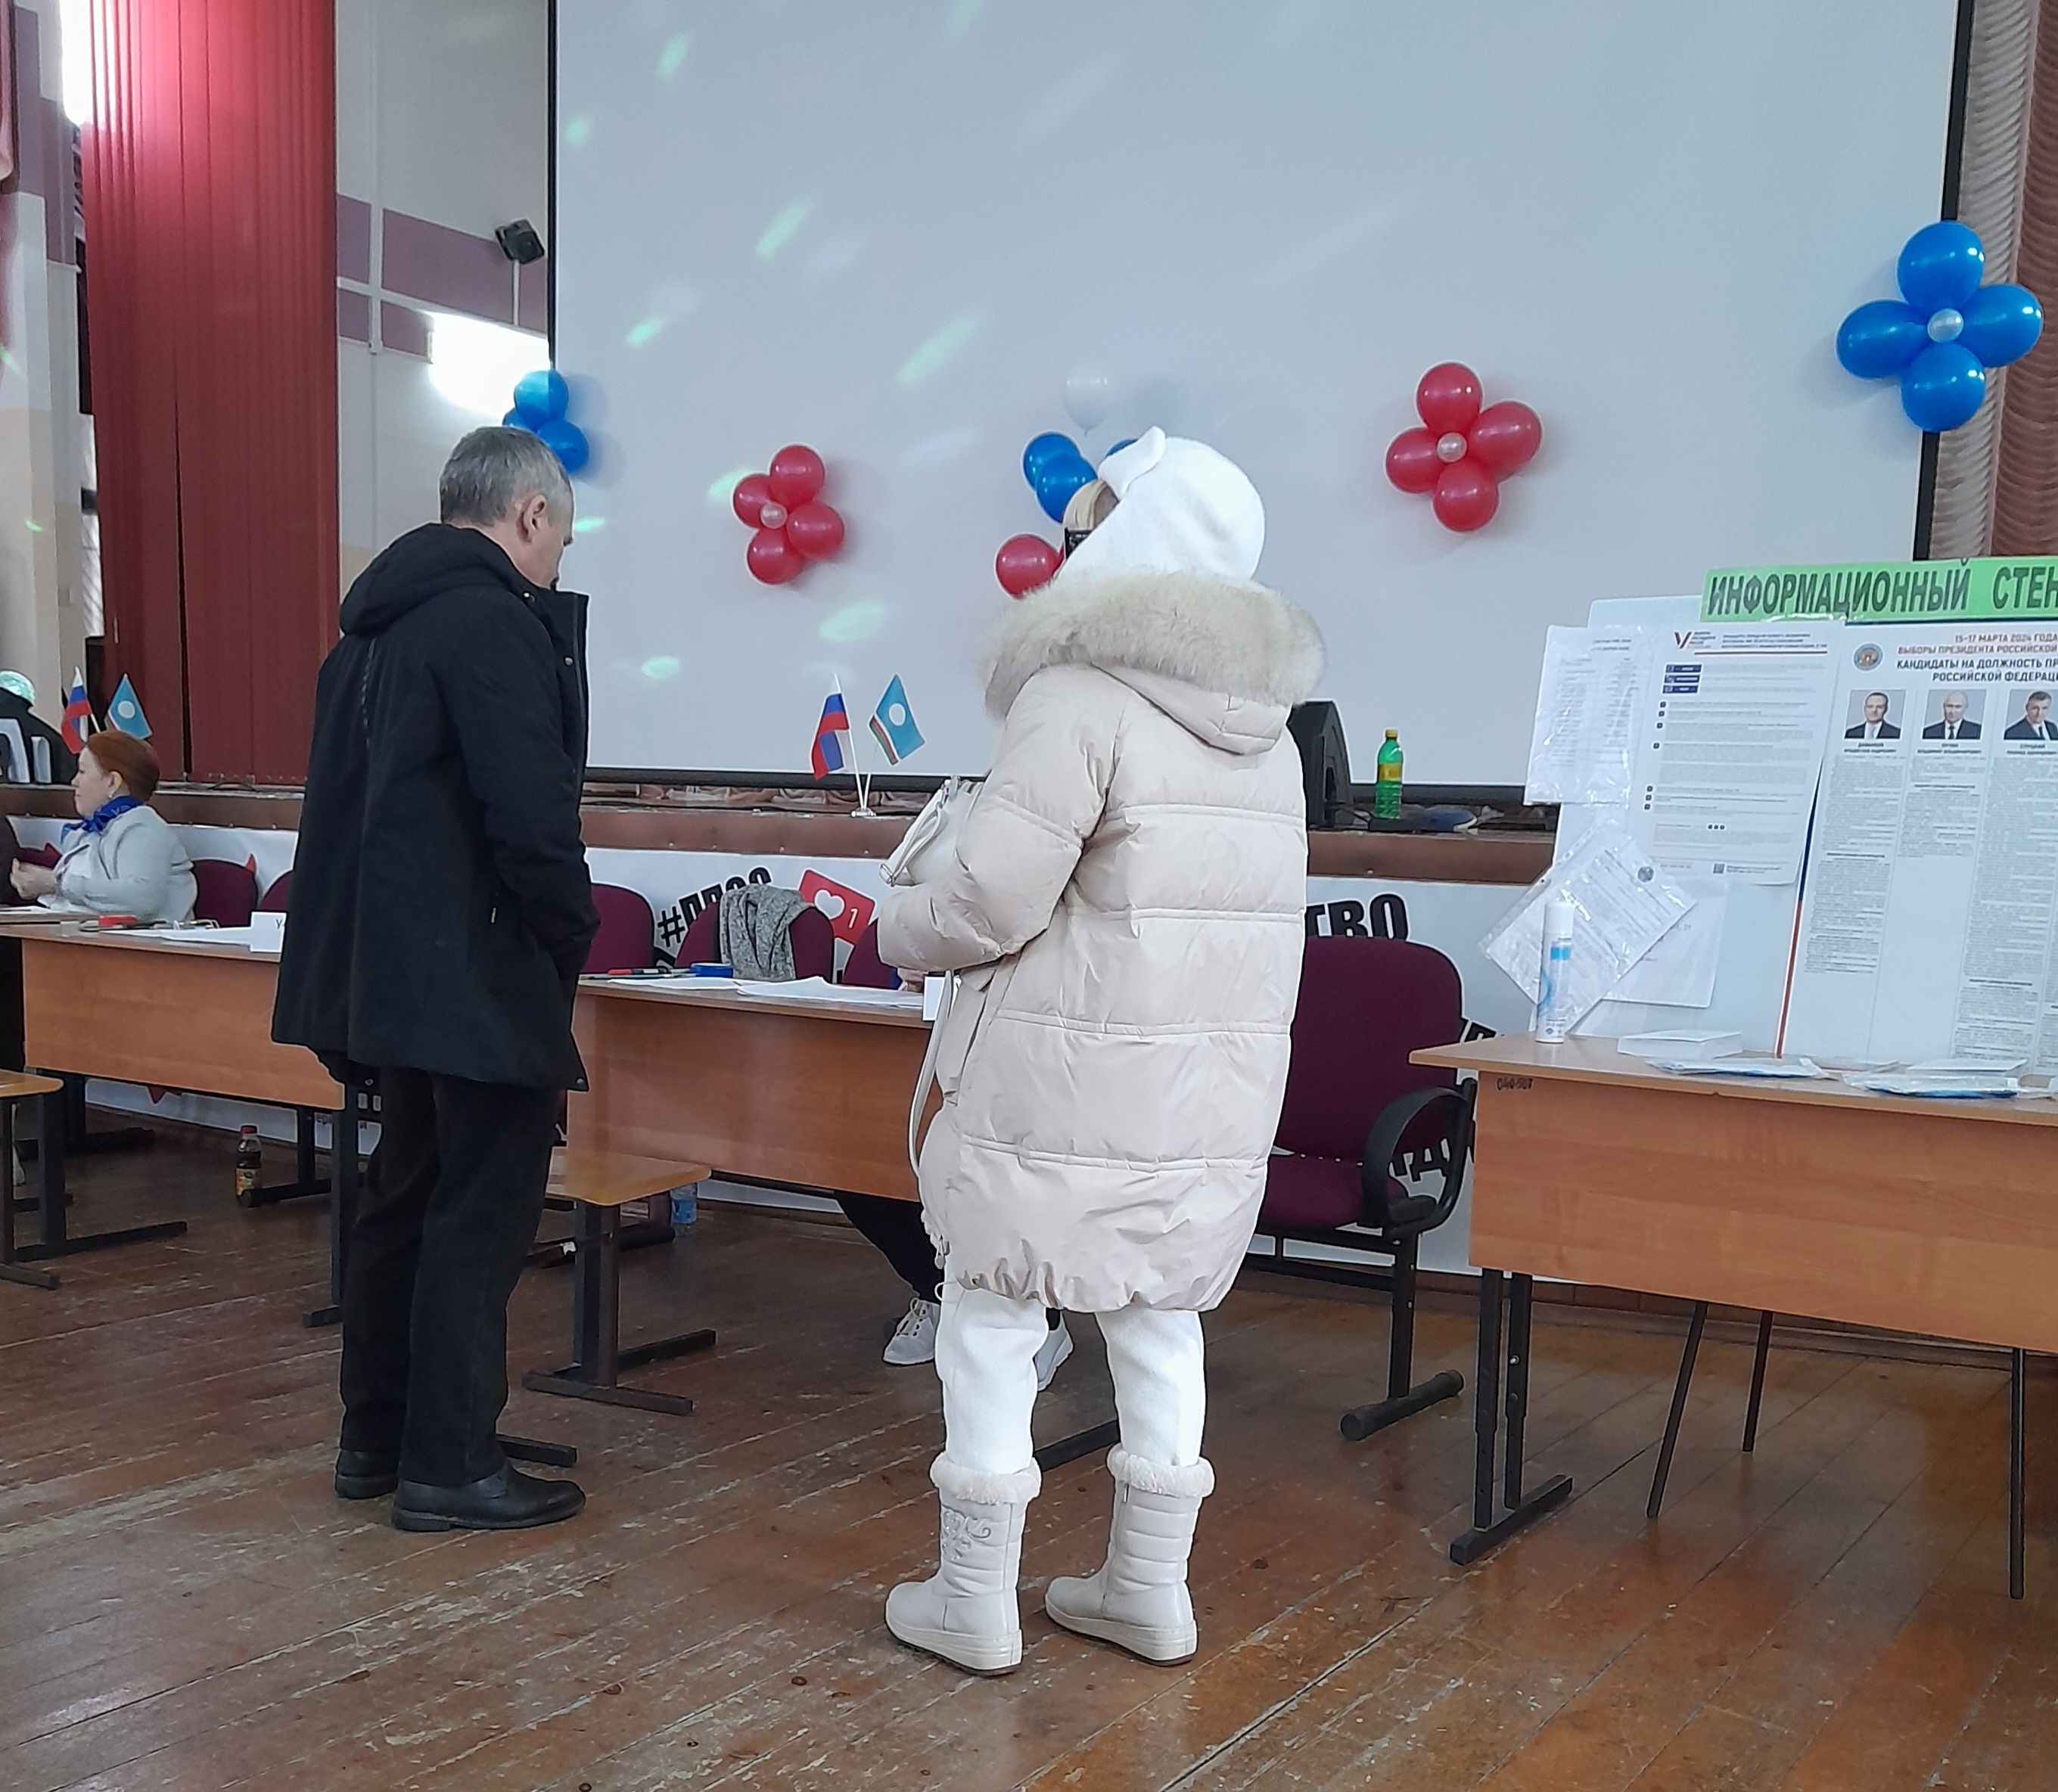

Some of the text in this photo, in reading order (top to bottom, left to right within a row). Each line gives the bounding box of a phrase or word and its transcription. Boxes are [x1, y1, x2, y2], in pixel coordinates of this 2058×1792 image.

[1708, 558, 2058, 616] ИНФОРМАЦИОННЫЙ СТЕН
[1955, 632, 2058, 643] 15-17 МАРТА 2024 ГОДА
[1898, 643, 2058, 654] ВЫБОРЫ ПРЕЗИДЕНТА РОССИЙСКОЙ
[1897, 659, 1959, 669] КАНДИДАТЫ
[1961, 659, 1974, 668] НА
[1976, 658, 2042, 669] ДОЛЖНОСТЬ
[1932, 669, 2002, 682] РОССИЙСКОЙ
